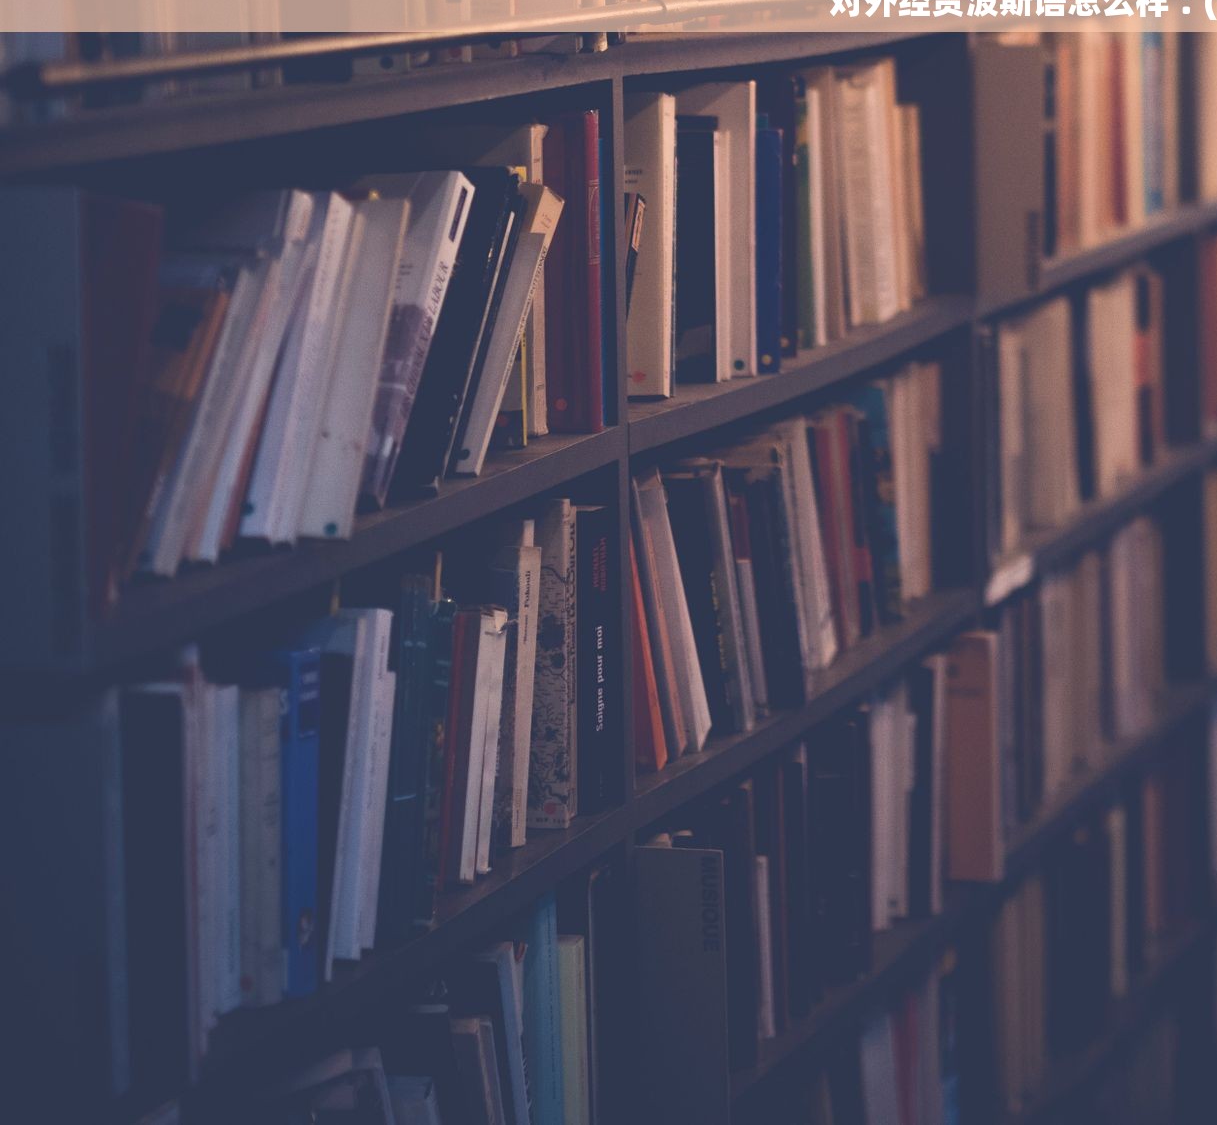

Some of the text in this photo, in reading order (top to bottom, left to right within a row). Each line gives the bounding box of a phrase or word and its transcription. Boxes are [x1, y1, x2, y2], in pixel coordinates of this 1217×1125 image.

[427, 260, 449, 316] LABOUR
[595, 625, 605, 732] Saigne pour moi
[701, 856, 720, 953] MUSIQUE
